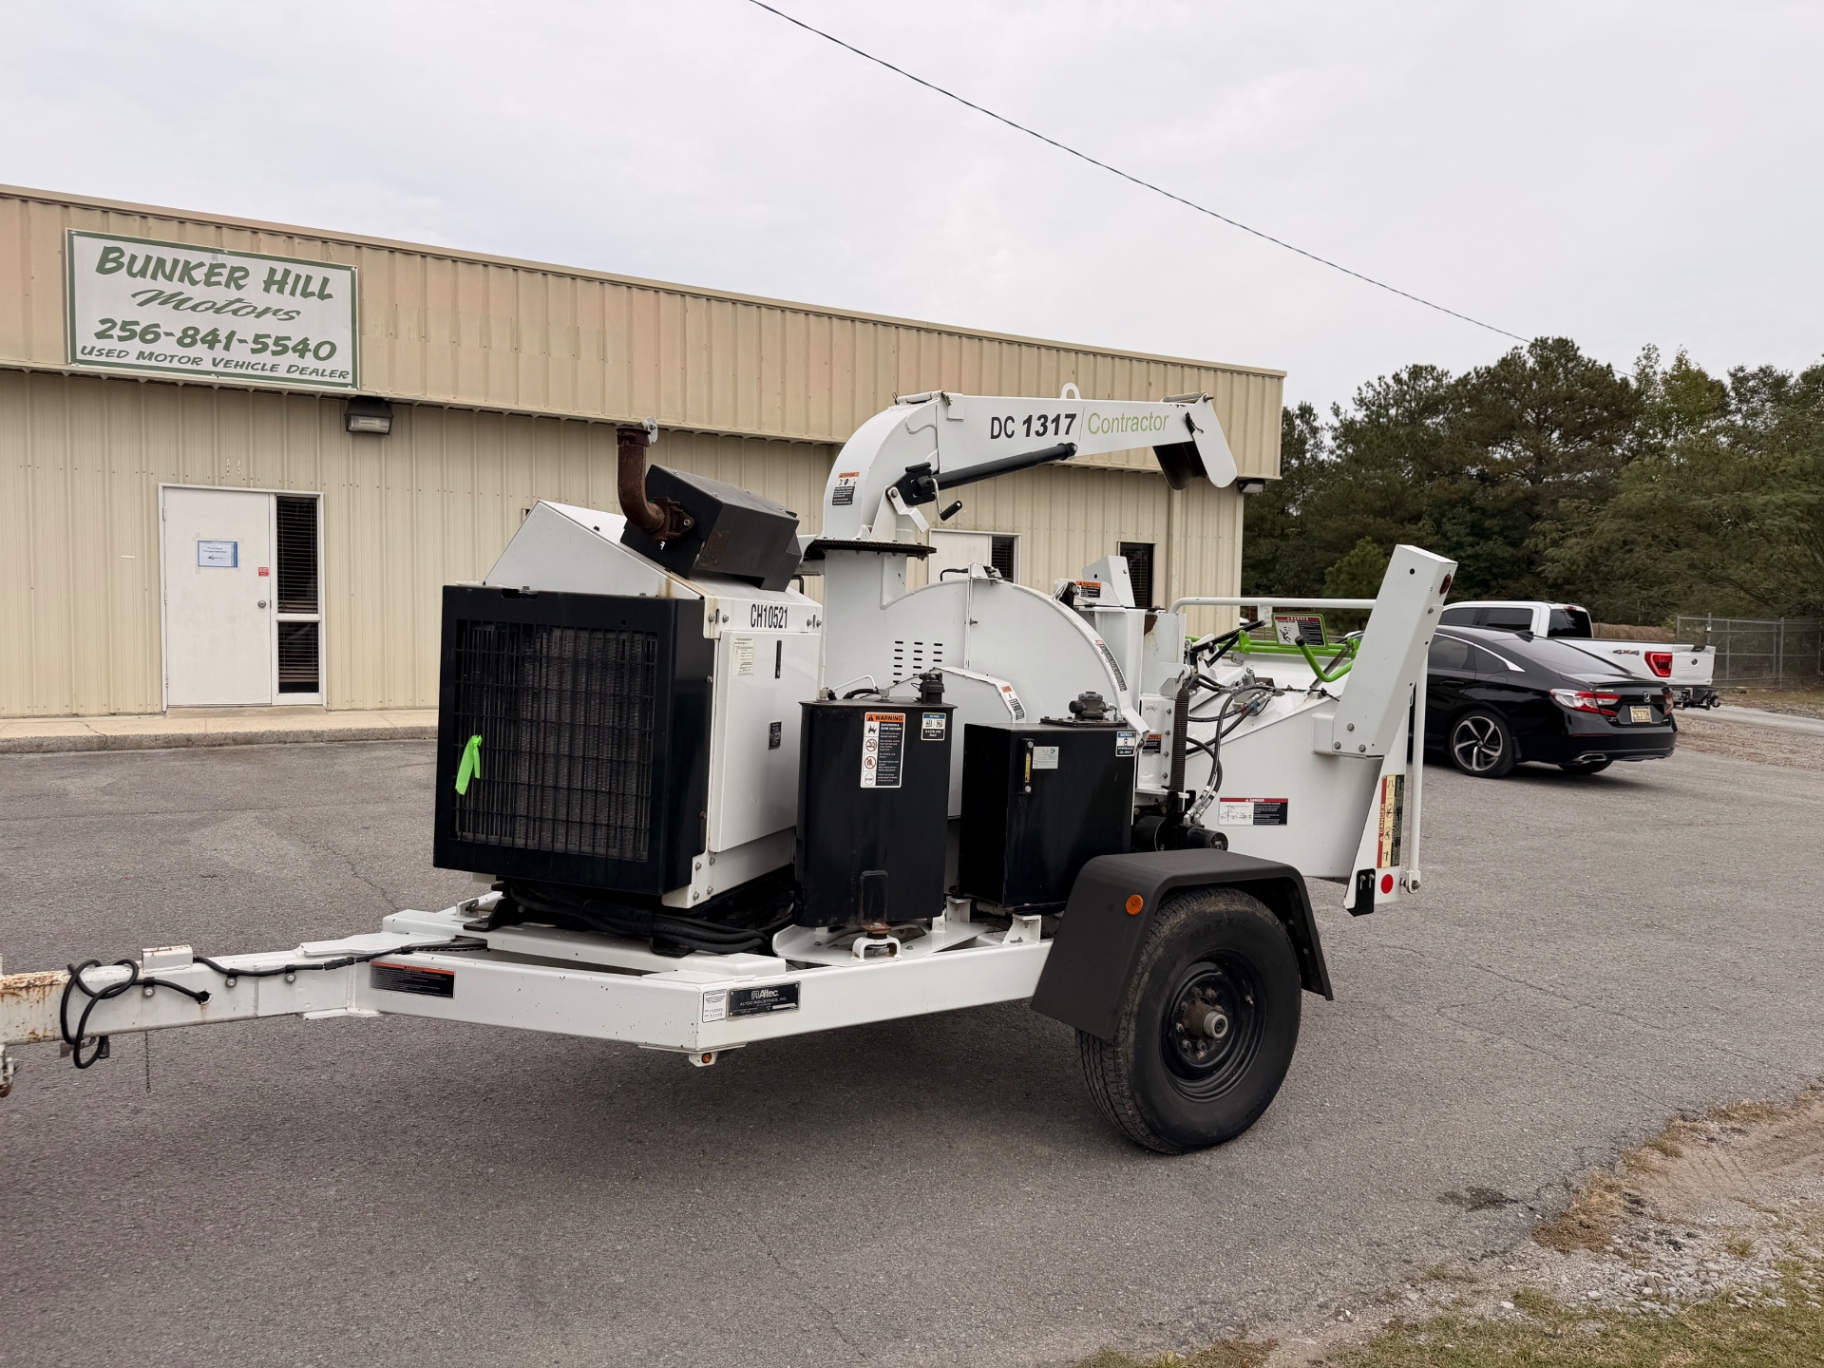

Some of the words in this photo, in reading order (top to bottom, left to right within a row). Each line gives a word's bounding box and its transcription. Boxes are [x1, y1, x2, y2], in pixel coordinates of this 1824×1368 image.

[95, 245, 250, 291] BUNKER
[263, 265, 334, 301] HILL
[130, 288, 301, 322] Motors
[94, 318, 337, 362] 256-841-5540
[80, 345, 129, 359] USED
[135, 350, 204, 367] MOTOR
[211, 357, 281, 373] VEHICLE
[286, 364, 350, 380] DEALER
[990, 416, 1016, 440] DC
[1021, 413, 1077, 438] 1317
[1087, 411, 1170, 435] Contractor
[750, 603, 788, 629] CH10521
